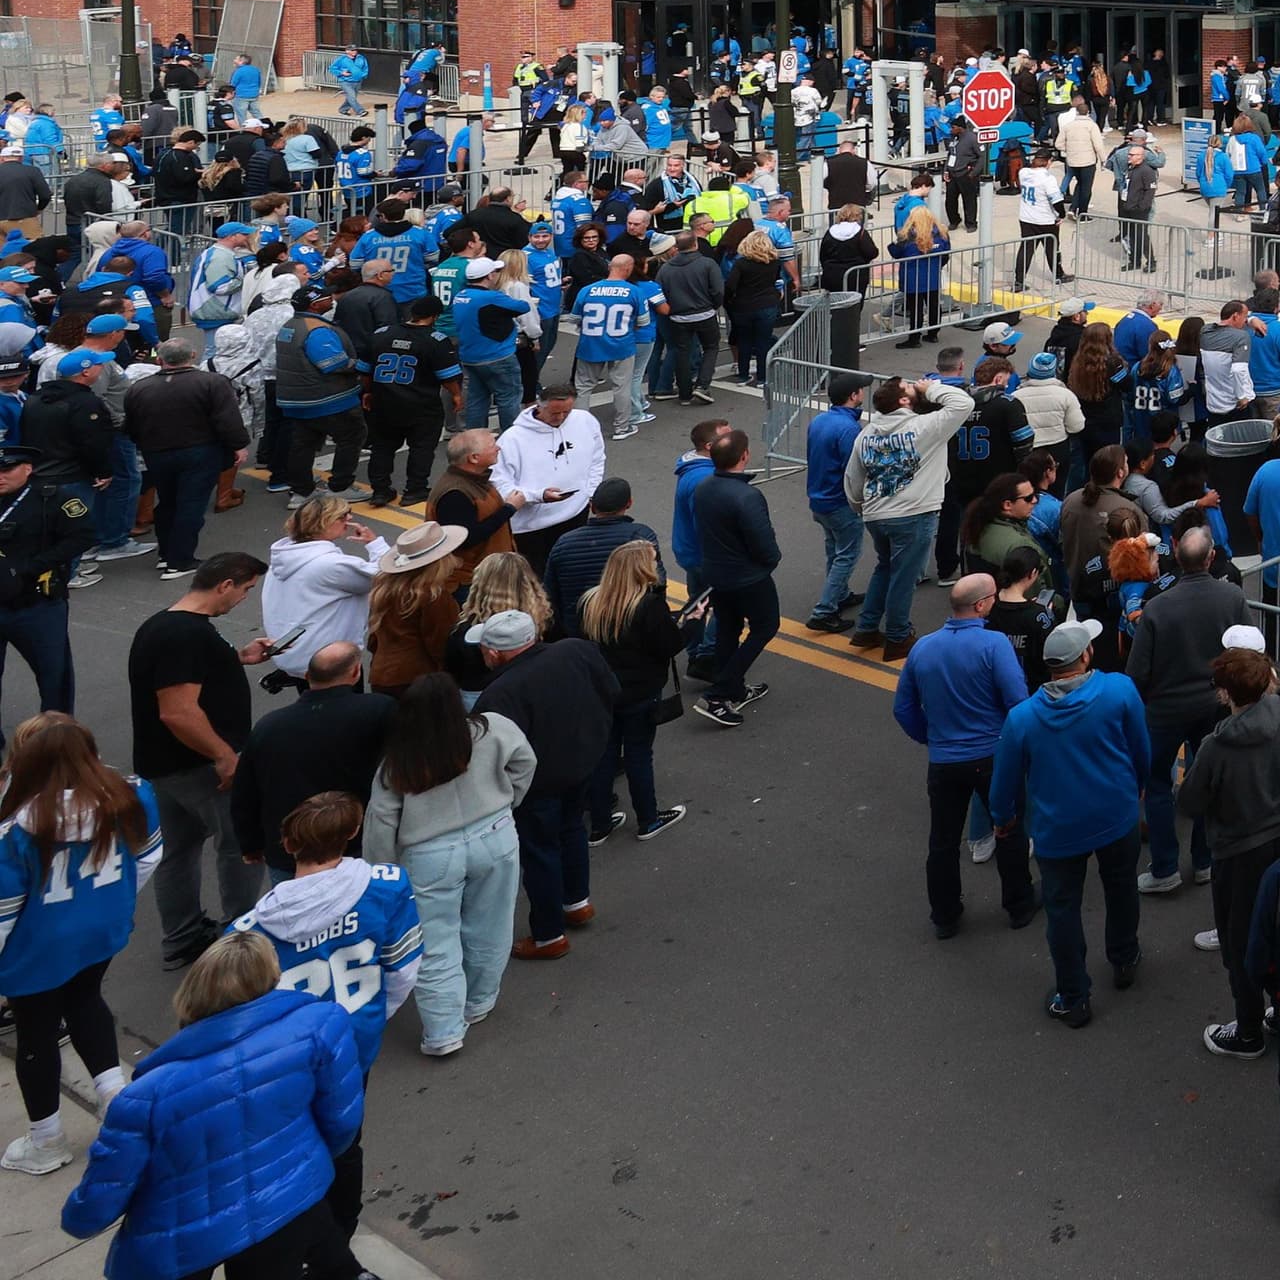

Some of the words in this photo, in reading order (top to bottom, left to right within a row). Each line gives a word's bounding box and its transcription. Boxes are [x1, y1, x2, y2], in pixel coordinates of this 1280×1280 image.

[966, 88, 1010, 111] STOP
[336, 161, 352, 180] 16
[371, 234, 412, 244] CAMPBELL
[432, 280, 451, 306] 16
[589, 284, 630, 298] SANDERS
[581, 302, 634, 338] 20
[373, 352, 418, 386] 26
[1135, 385, 1161, 412] 88
[957, 425, 990, 462] 16
[42, 834, 123, 905] 14
